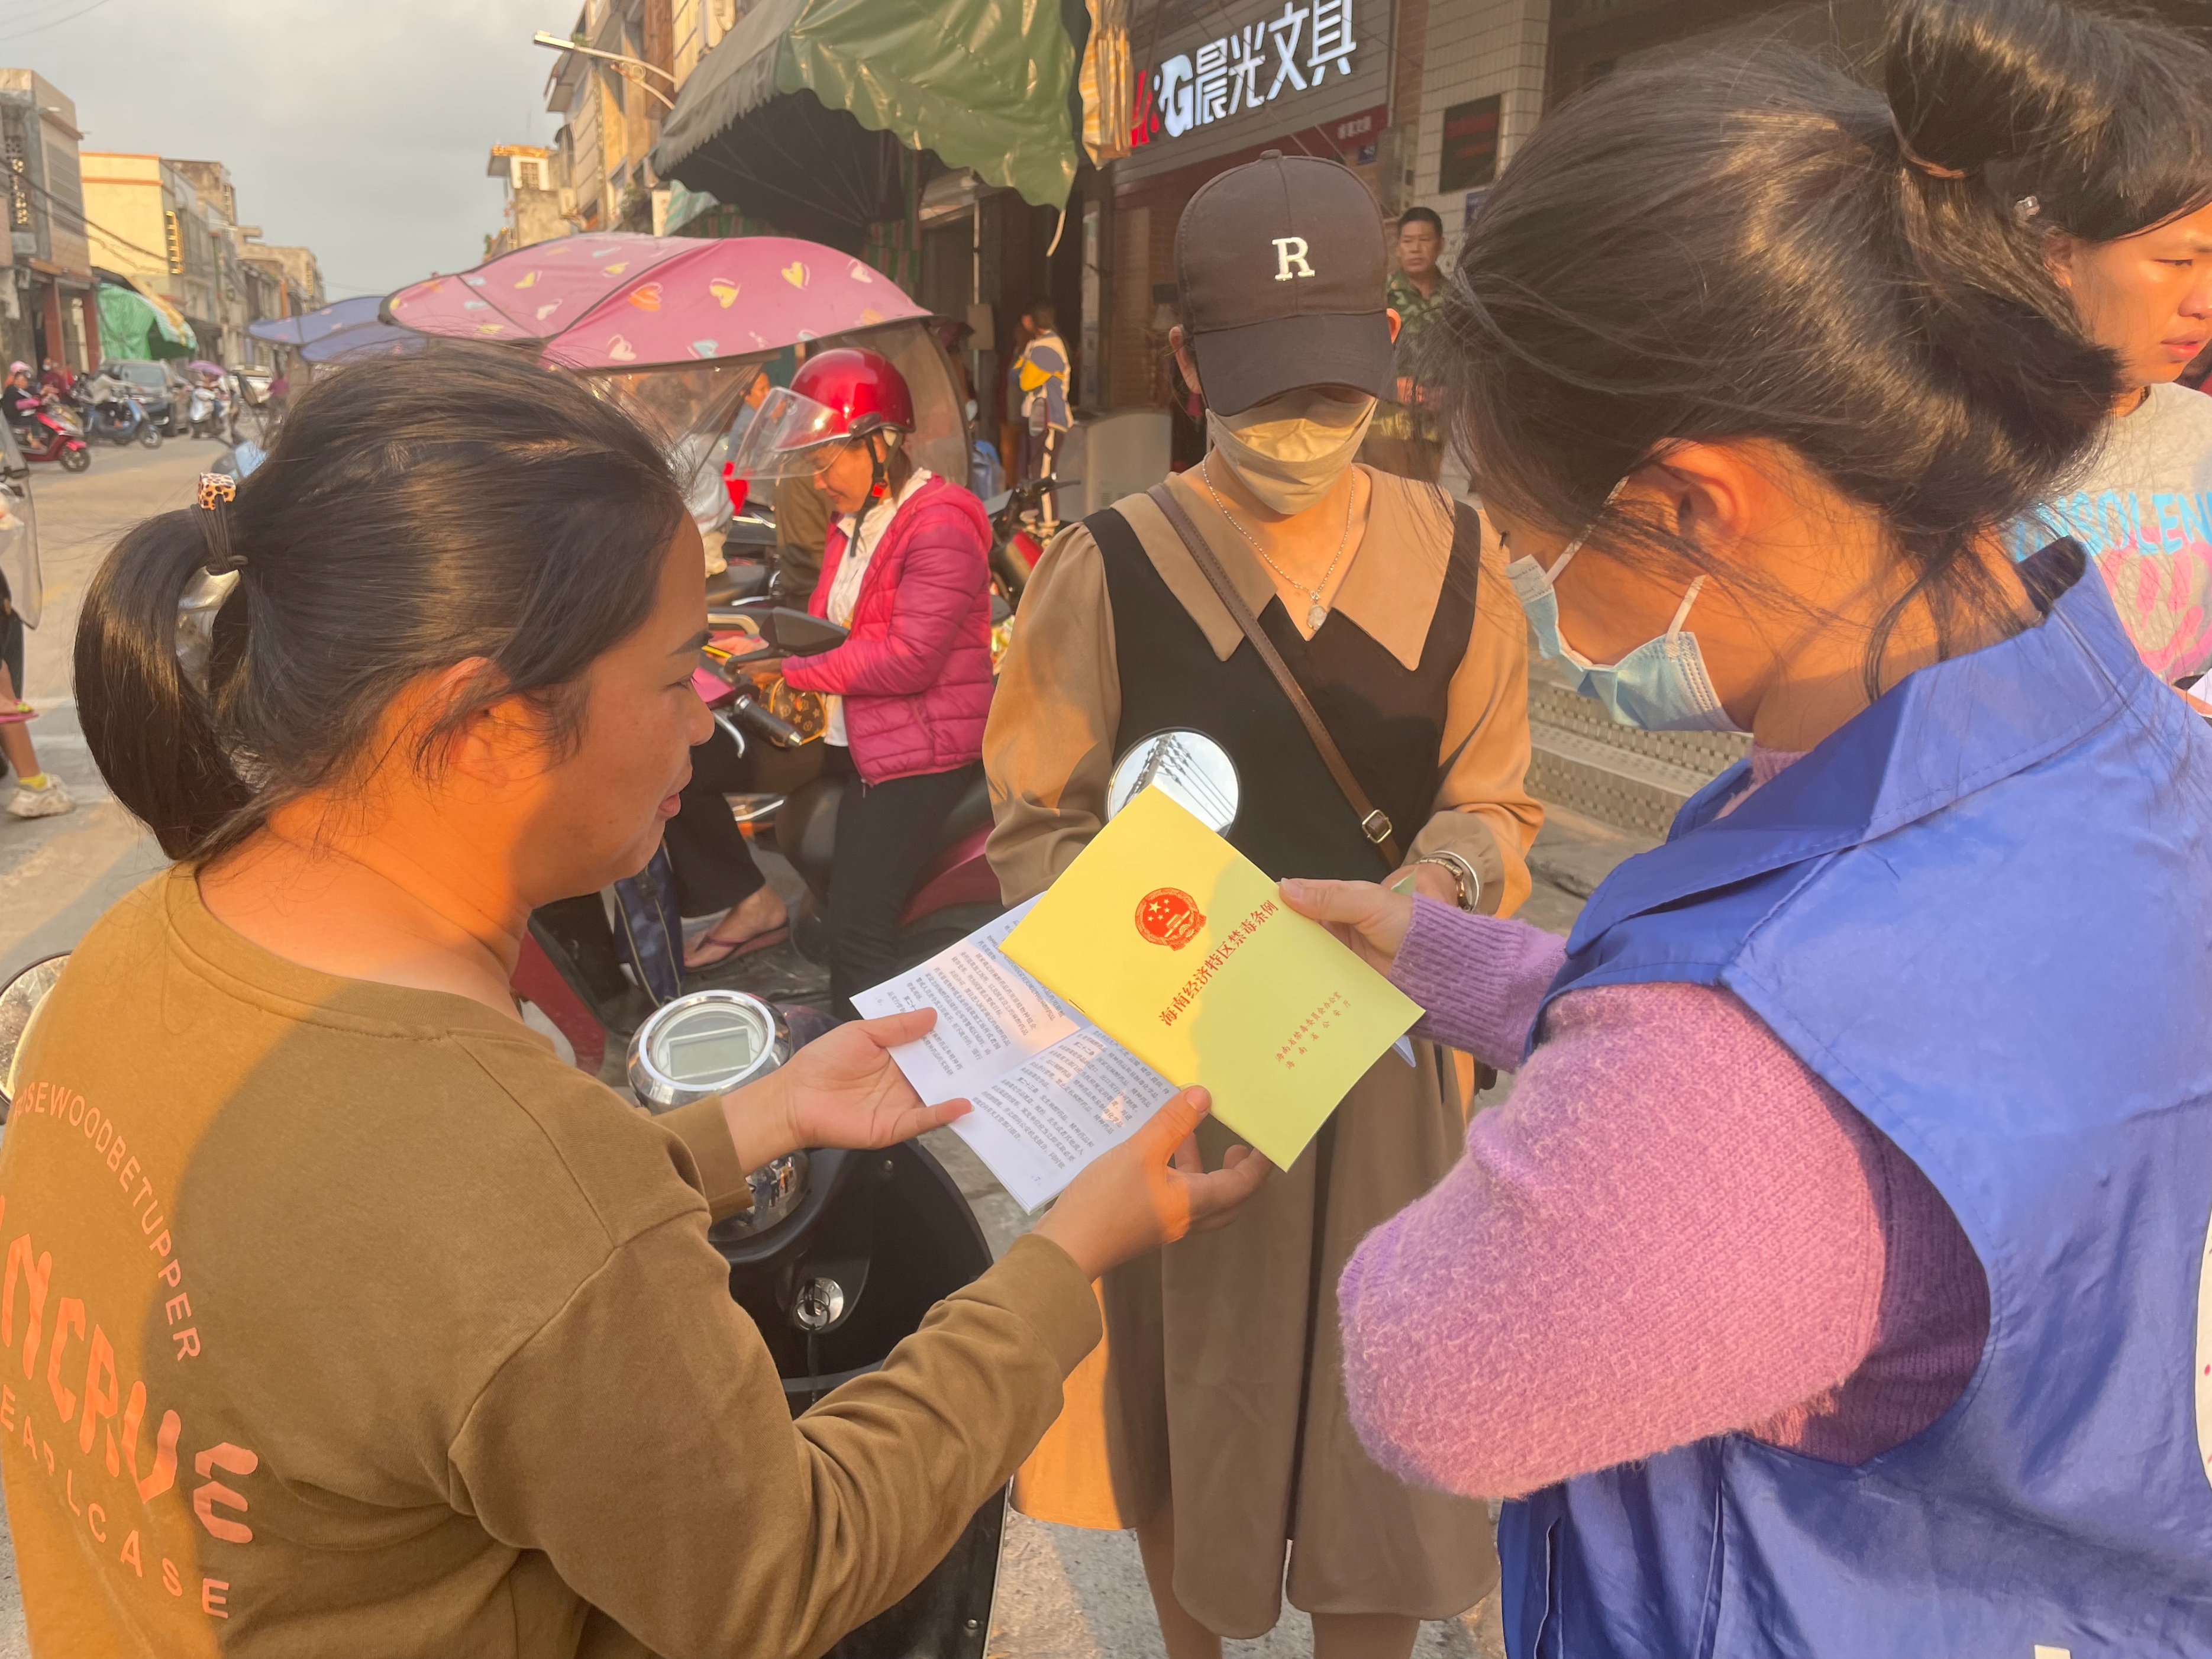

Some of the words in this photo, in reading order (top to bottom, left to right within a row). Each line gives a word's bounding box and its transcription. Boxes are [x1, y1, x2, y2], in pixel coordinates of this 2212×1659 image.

[1194, 0, 1357, 125] 晨光文具
[1272, 237, 1315, 281] R
[1158, 900, 1279, 1027] 海南经济特区禁毒条例
[1275, 991, 1342, 1062] 海南省禁毒委员会办公室
